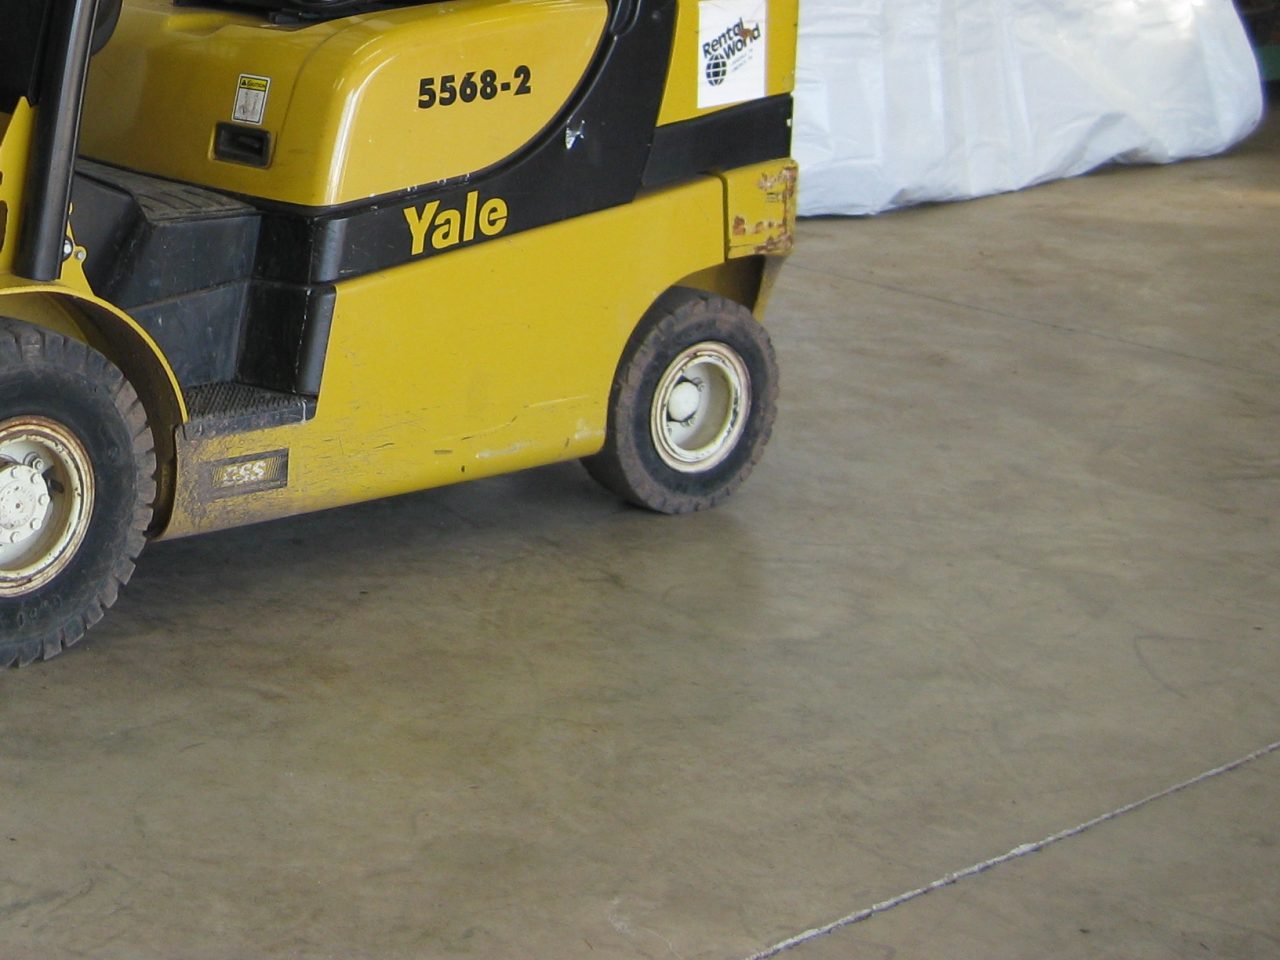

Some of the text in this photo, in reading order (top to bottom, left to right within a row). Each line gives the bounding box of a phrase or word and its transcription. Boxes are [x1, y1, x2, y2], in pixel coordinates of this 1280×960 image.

[702, 17, 744, 58] Rental
[418, 65, 532, 109] 5568-2
[403, 190, 508, 256] Yale
